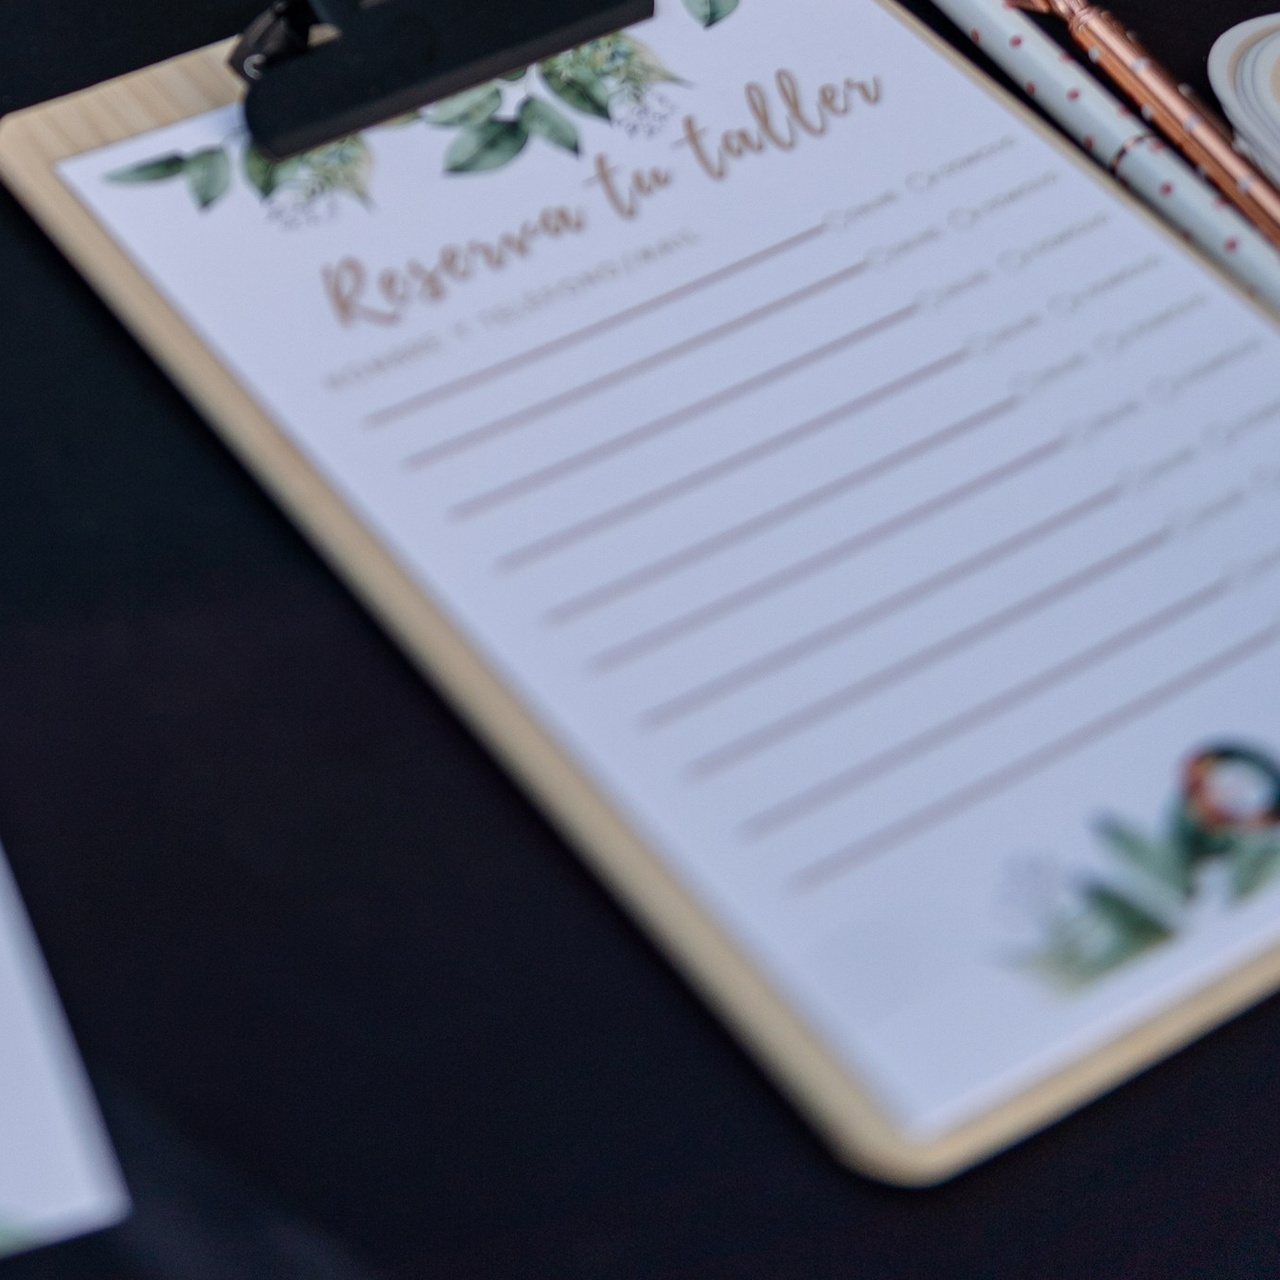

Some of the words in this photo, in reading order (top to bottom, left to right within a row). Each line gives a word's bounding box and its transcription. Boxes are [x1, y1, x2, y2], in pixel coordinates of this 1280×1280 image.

[321, 192, 588, 330] Reserva
[583, 150, 675, 220] tu
[672, 68, 884, 182] taller
